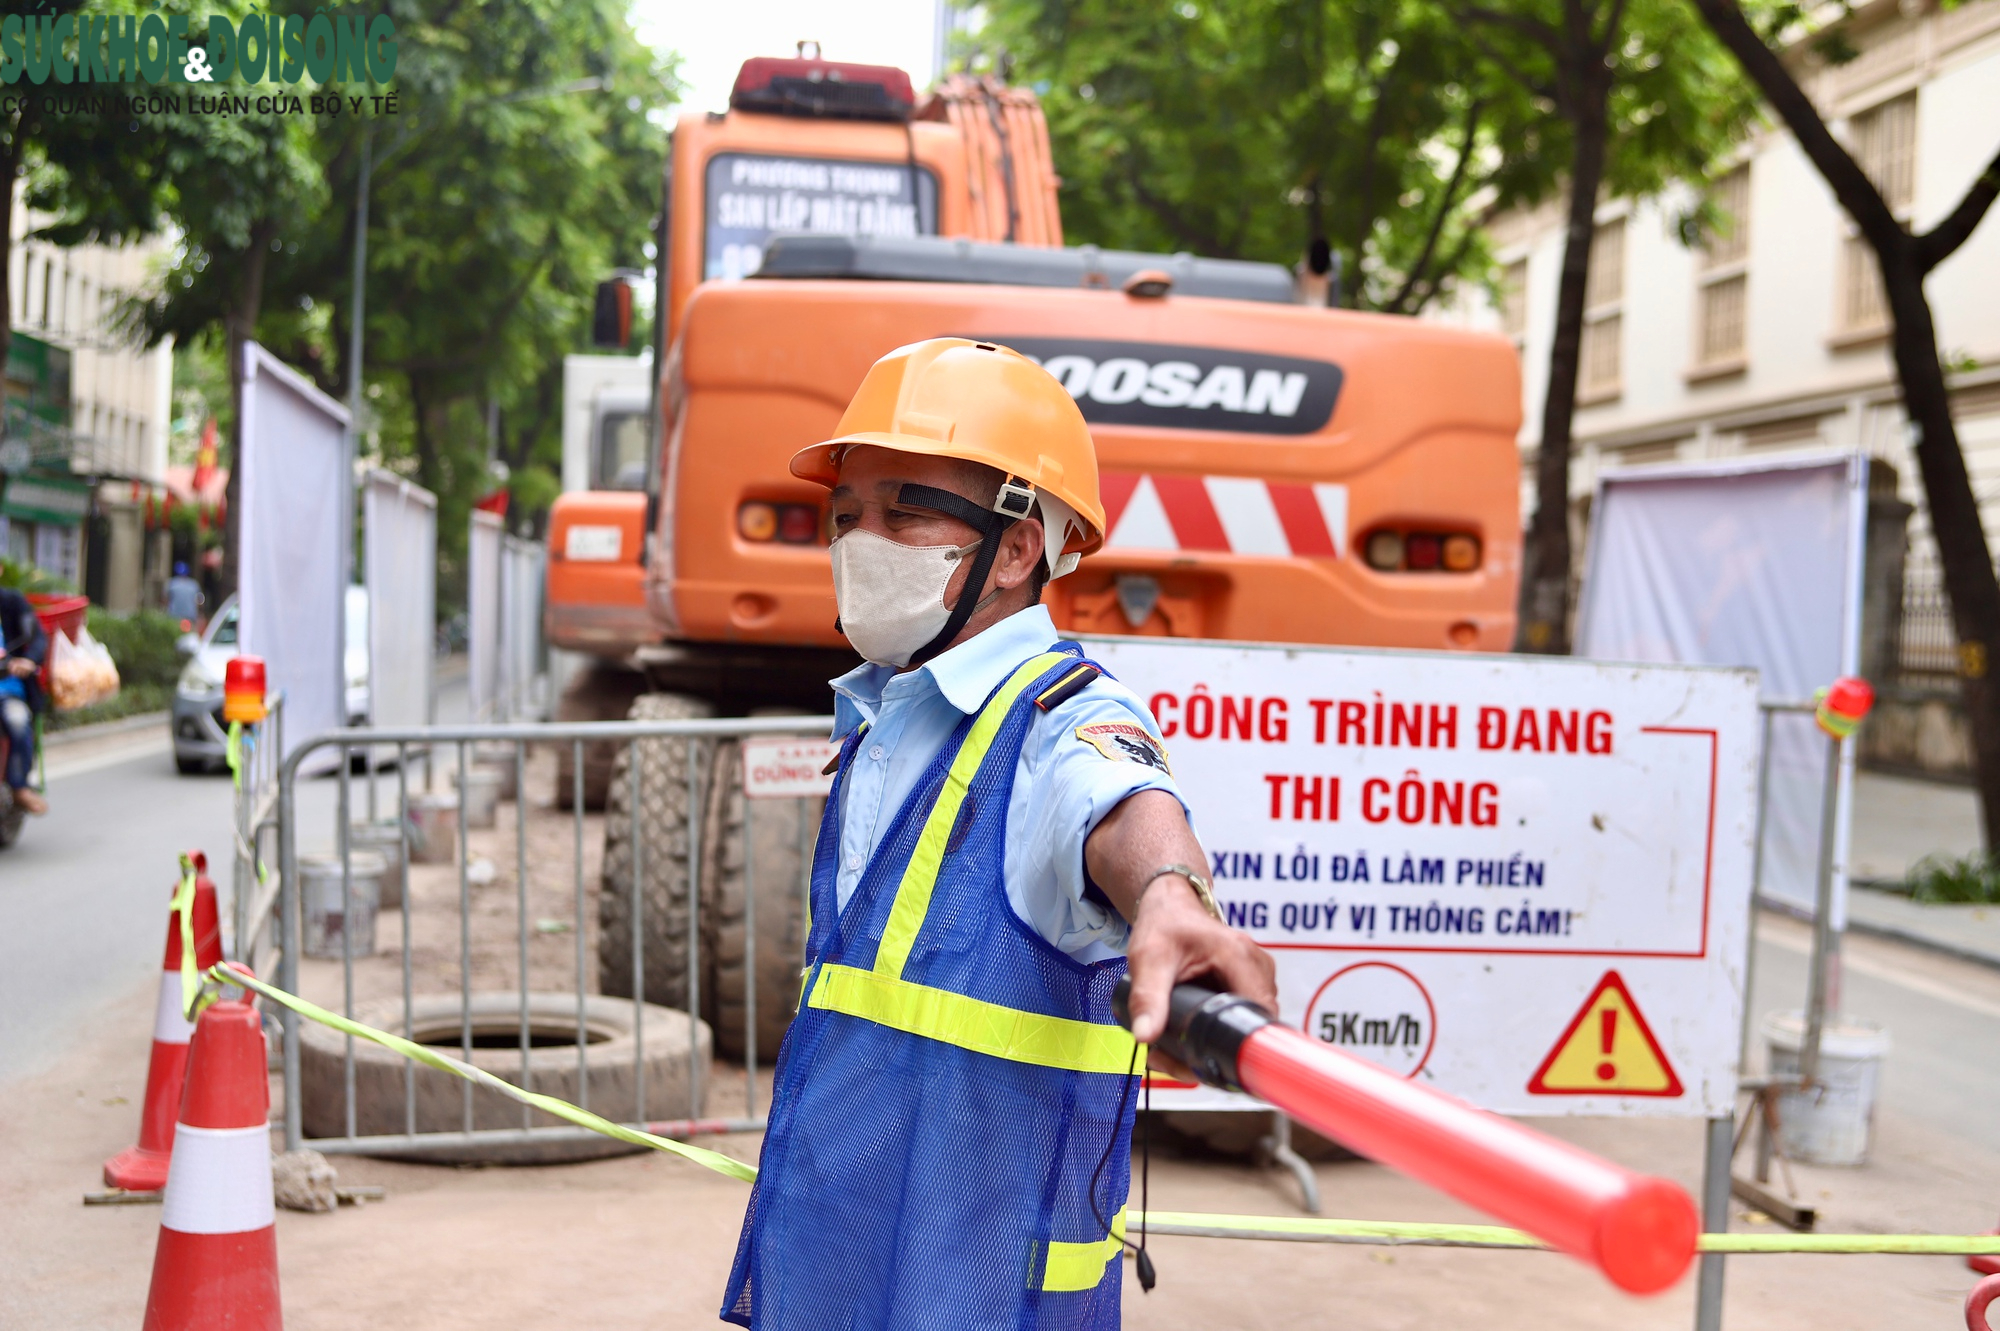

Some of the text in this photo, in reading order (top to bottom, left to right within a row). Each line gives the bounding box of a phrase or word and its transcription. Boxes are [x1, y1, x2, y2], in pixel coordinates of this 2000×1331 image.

[1023, 353, 1309, 417] OOSAN
[1151, 683, 1613, 755] CÔNG TRÌNH ĐANG
[1264, 769, 1499, 826] THI CÔNG
[1212, 852, 1262, 880] XIN
[1331, 850, 1370, 883] ĐÃ
[1382, 850, 1444, 885] LÀM
[1281, 898, 1338, 934] QUÝ
[1350, 905, 1376, 939] VỊ
[1388, 900, 1484, 934] THÔNG
[1320, 1013, 1420, 1045] 5Km/h
